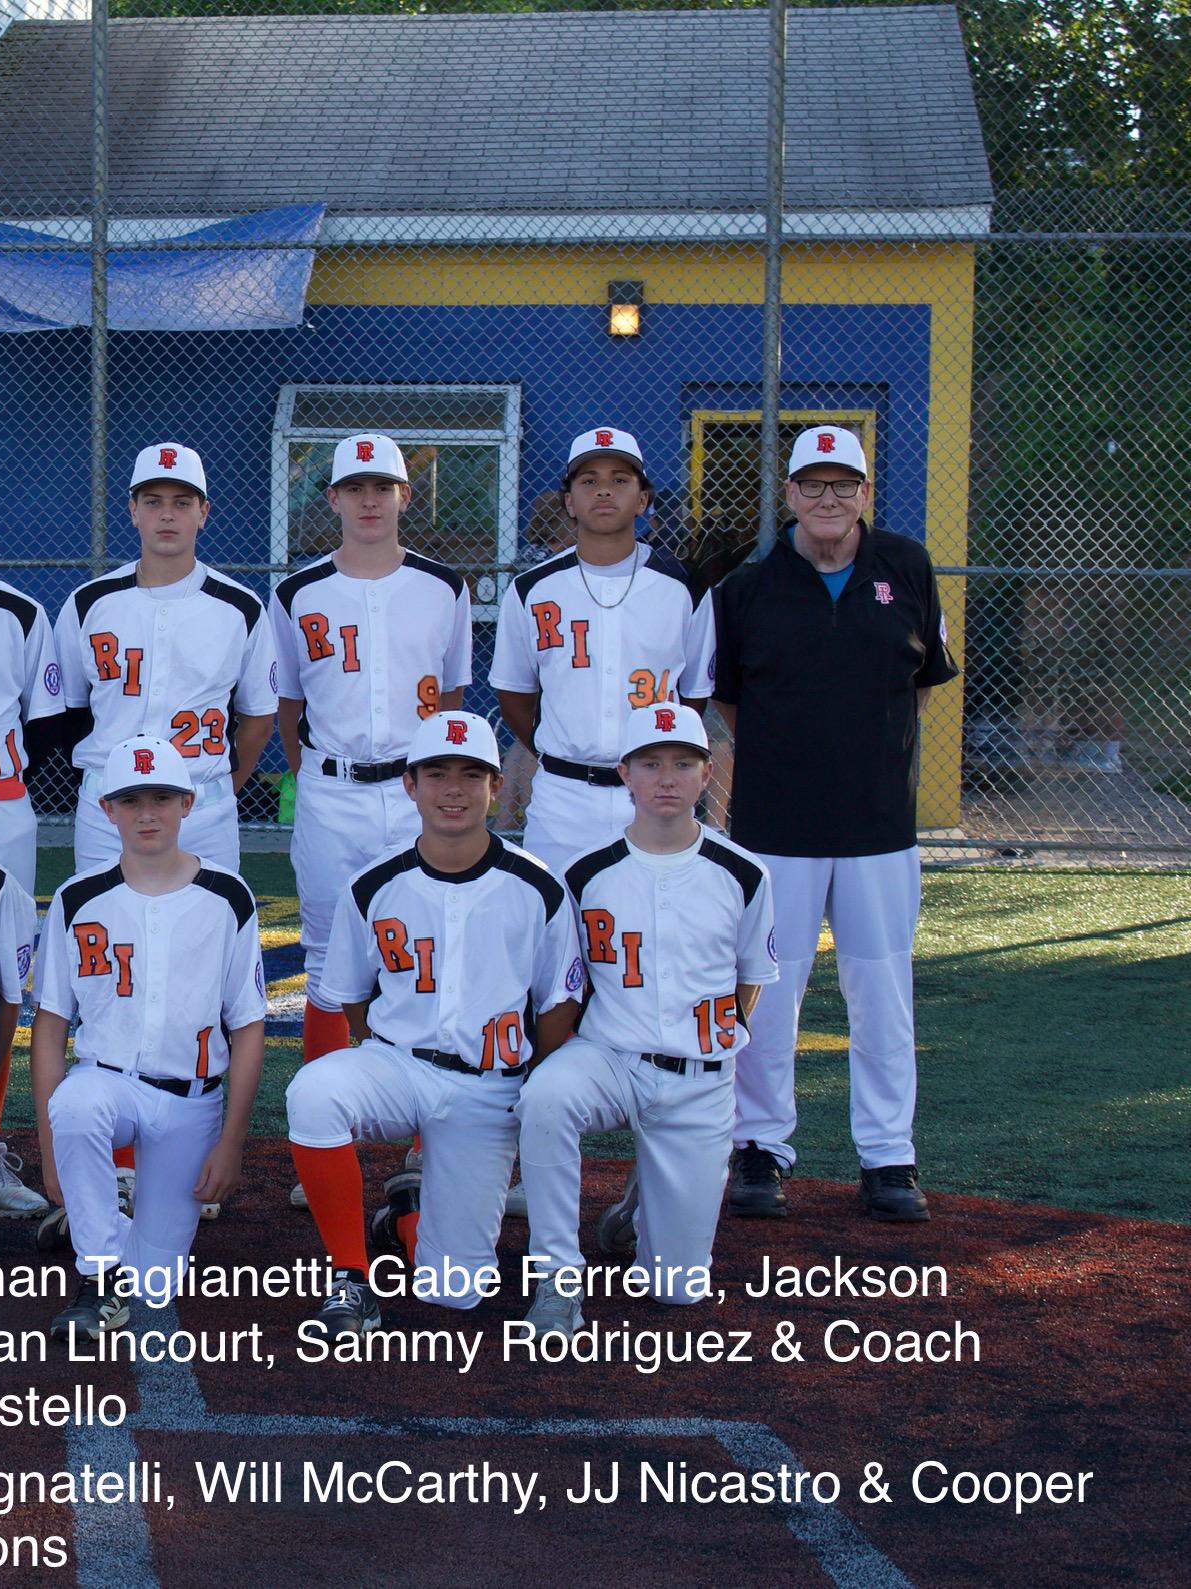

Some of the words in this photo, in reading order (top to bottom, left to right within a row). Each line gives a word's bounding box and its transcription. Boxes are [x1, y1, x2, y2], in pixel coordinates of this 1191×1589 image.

[90, 632, 143, 696] RI
[299, 613, 360, 672] RI
[531, 601, 590, 668] RI
[417, 675, 440, 720] 9
[169, 707, 226, 757] 23
[73, 922, 134, 997] RI
[373, 918, 436, 993] RI
[582, 909, 644, 988] RI
[196, 1027, 213, 1079] 1
[481, 1012, 522, 1070] 10
[694, 994, 737, 1054] 15
